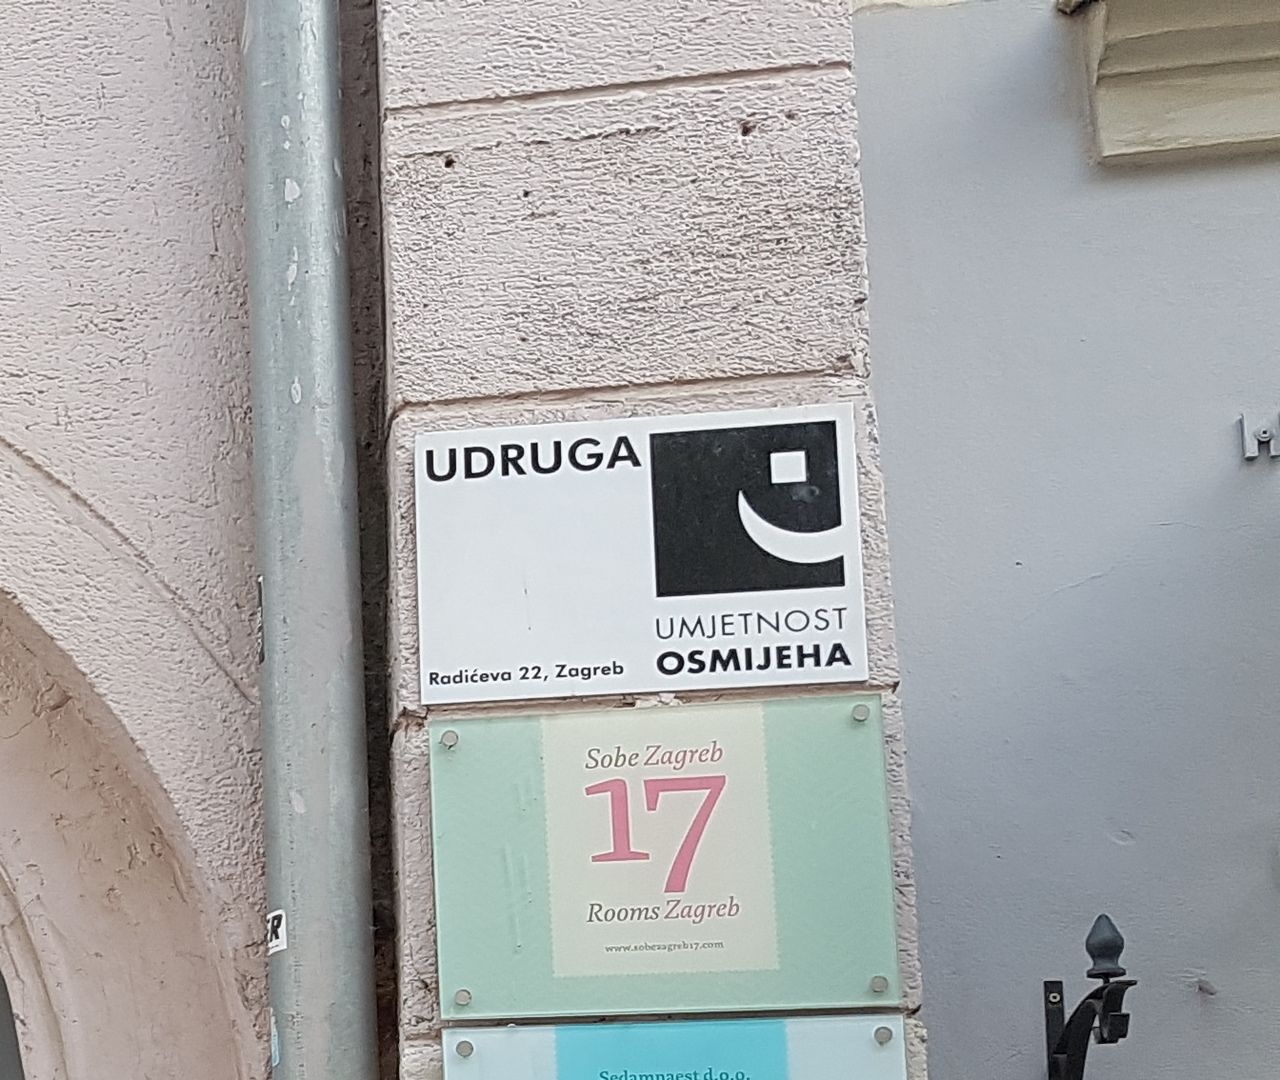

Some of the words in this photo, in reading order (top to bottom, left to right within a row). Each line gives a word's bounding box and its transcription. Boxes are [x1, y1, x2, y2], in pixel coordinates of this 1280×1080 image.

[425, 435, 642, 483] UDRUGA
[655, 607, 848, 641] UMJETNOST
[429, 668, 512, 686] Radićeva
[519, 665, 549, 682] 22,
[555, 660, 625, 681] Zagreb
[656, 643, 852, 676] OSMIJEHA
[585, 746, 640, 769] Sobe
[644, 740, 723, 771] Zagreb
[585, 775, 726, 893] 17
[587, 902, 661, 923] Rooms
[664, 895, 740, 925] Zagreb
[604, 940, 725, 953] www.sobezagreb17.com
